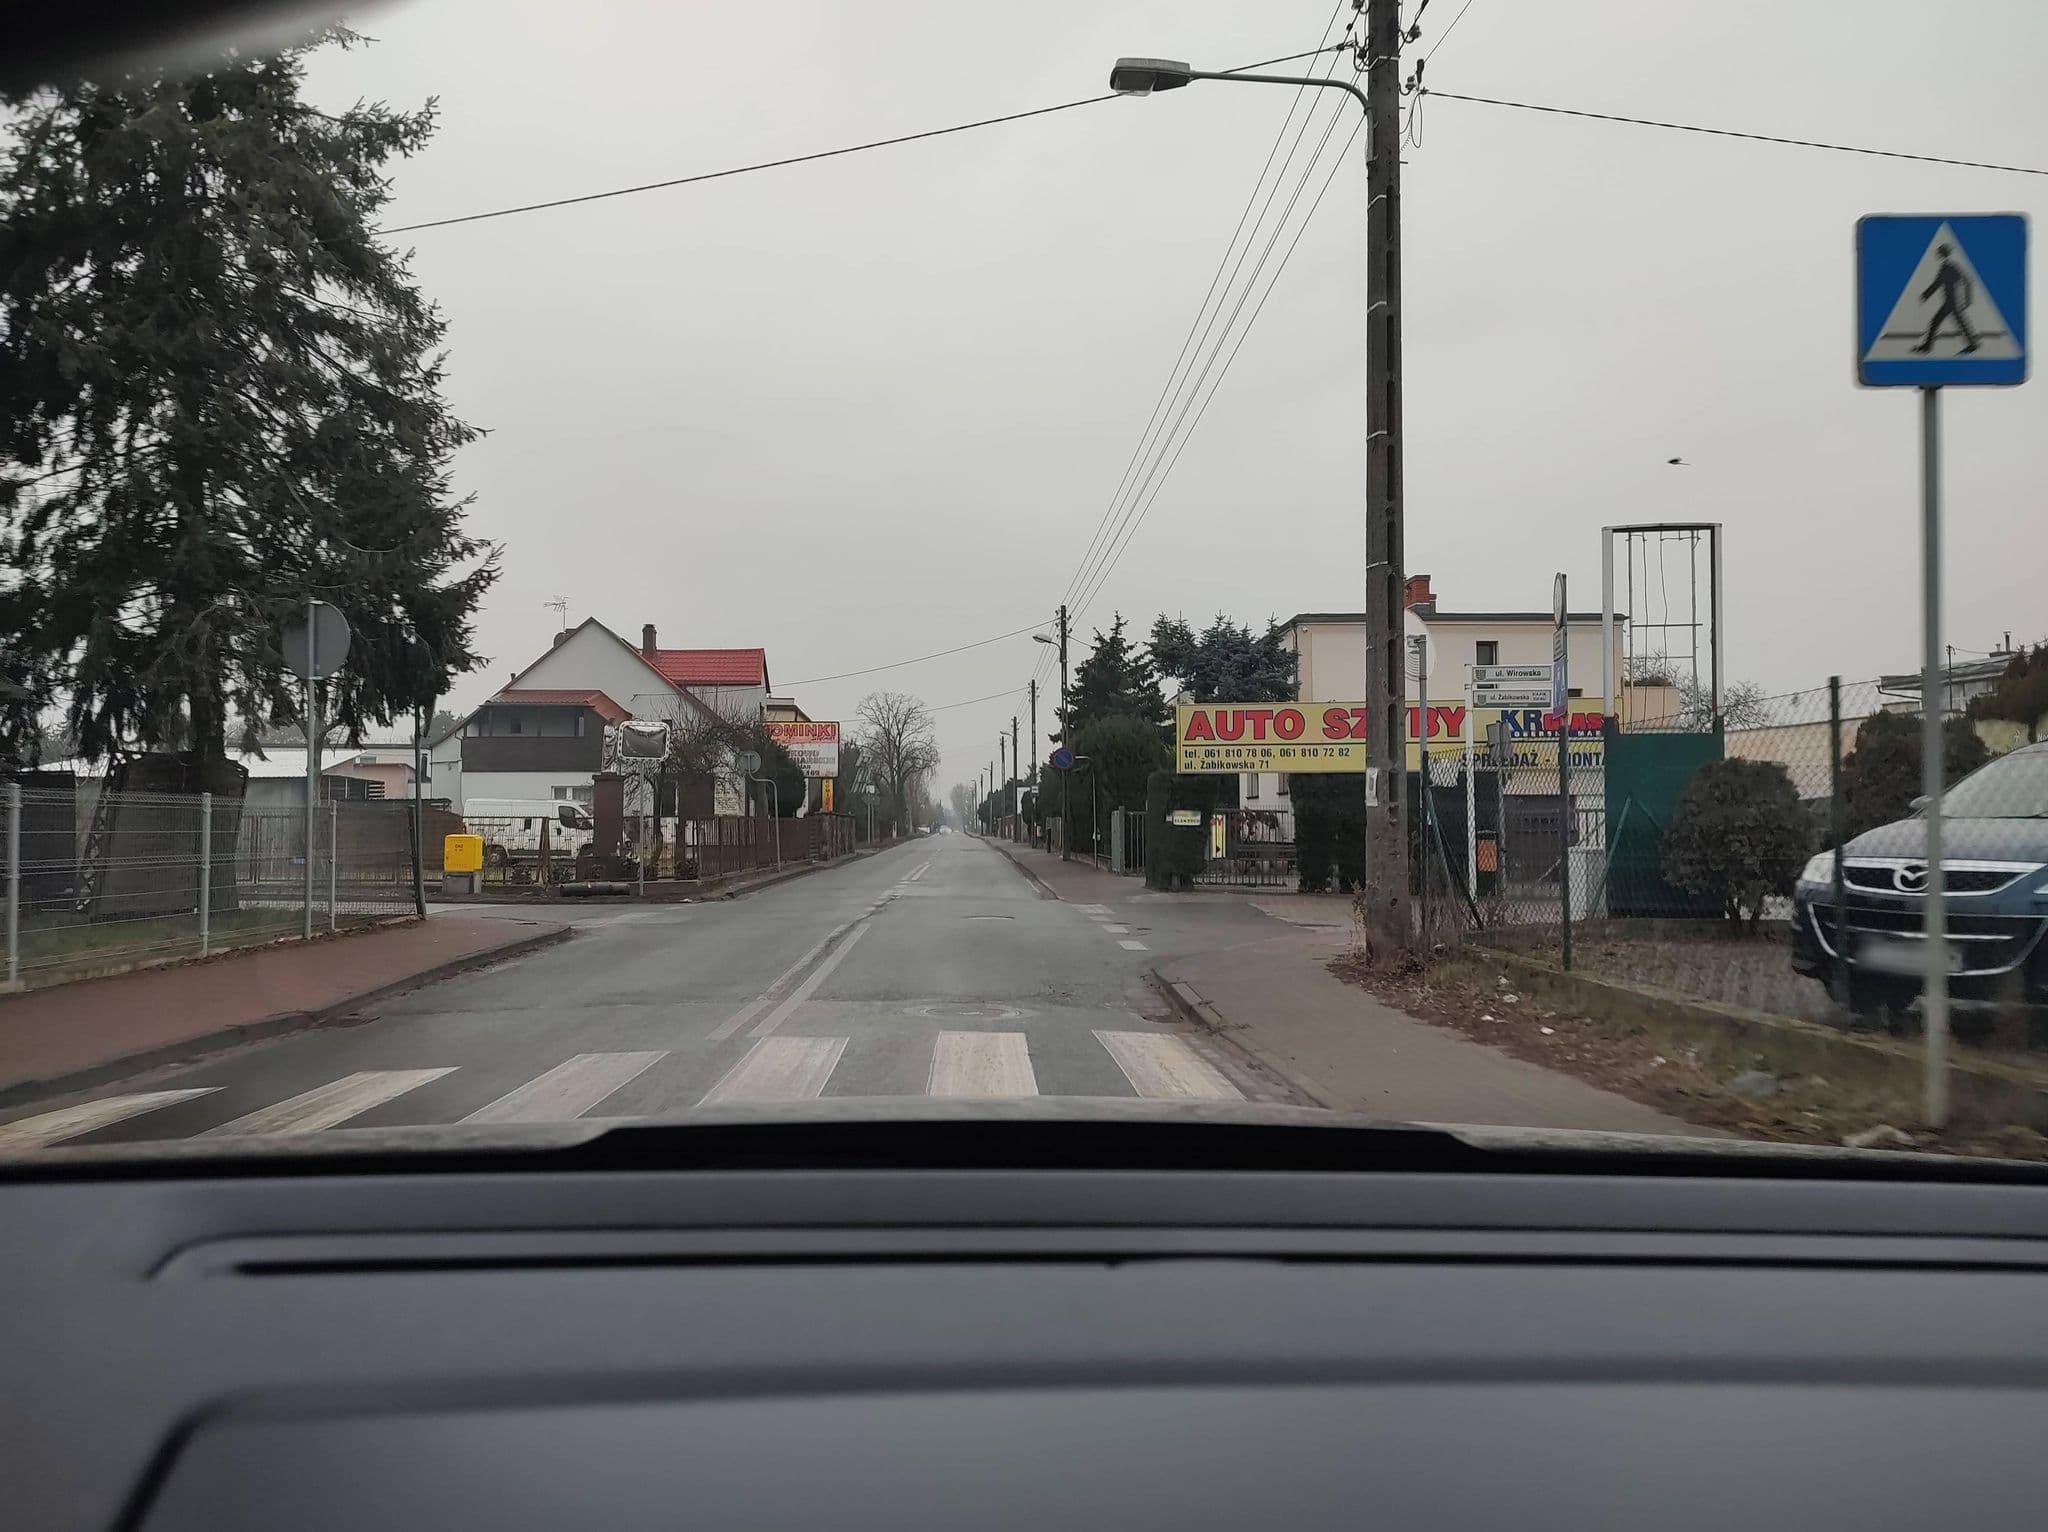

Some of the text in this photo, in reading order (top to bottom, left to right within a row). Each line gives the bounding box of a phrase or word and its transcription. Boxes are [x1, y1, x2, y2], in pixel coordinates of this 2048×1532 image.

[1495, 669, 1542, 677] ul. Wirowska
[1184, 707, 1466, 741] AUTO SZBY
[1184, 748, 1350, 759] tel. 061 810 78 06, 061 810 72 82
[1558, 751, 1604, 767] ONT
[1184, 757, 1269, 770] ul. Żabikowska 71
